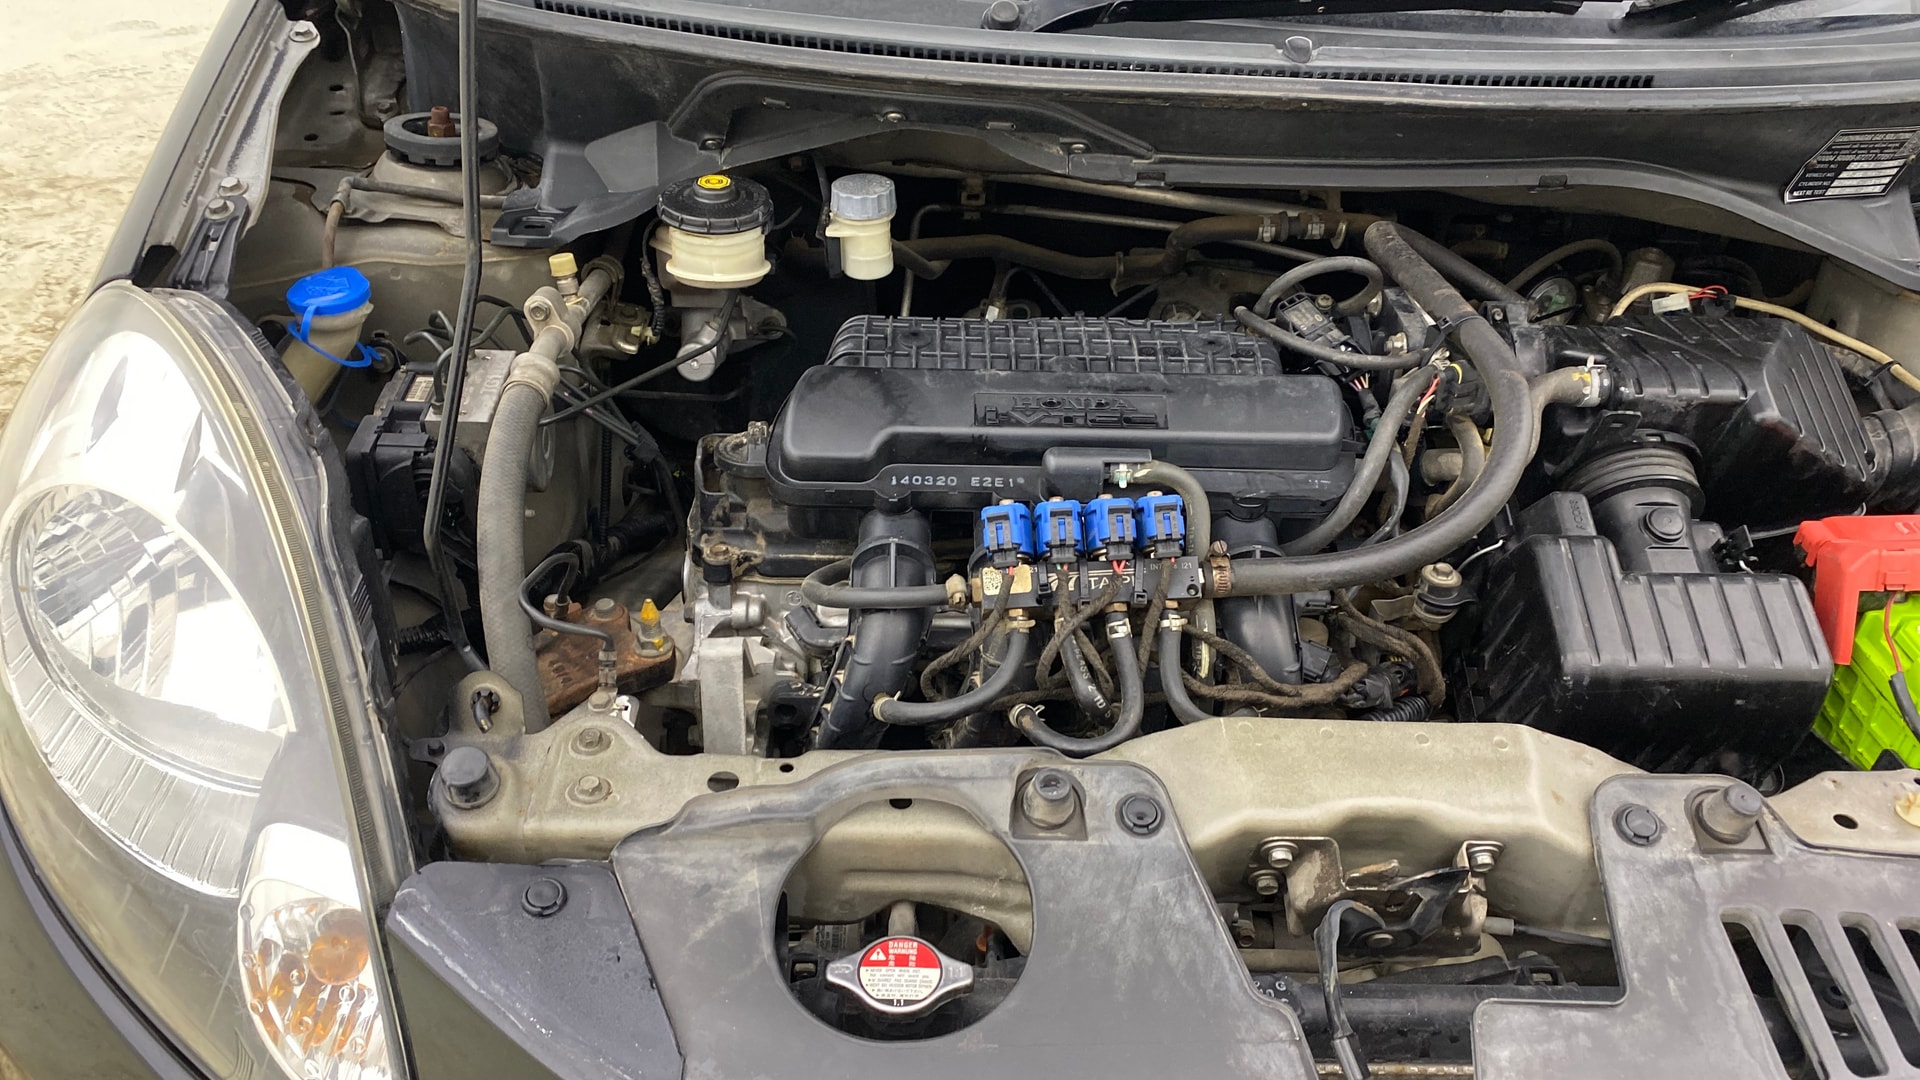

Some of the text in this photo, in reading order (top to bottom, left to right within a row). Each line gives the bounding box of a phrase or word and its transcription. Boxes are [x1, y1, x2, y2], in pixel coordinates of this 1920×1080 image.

[1013, 396, 1137, 411] HONDA
[890, 475, 958, 486] 140320
[888, 941, 918, 949] DANGER
